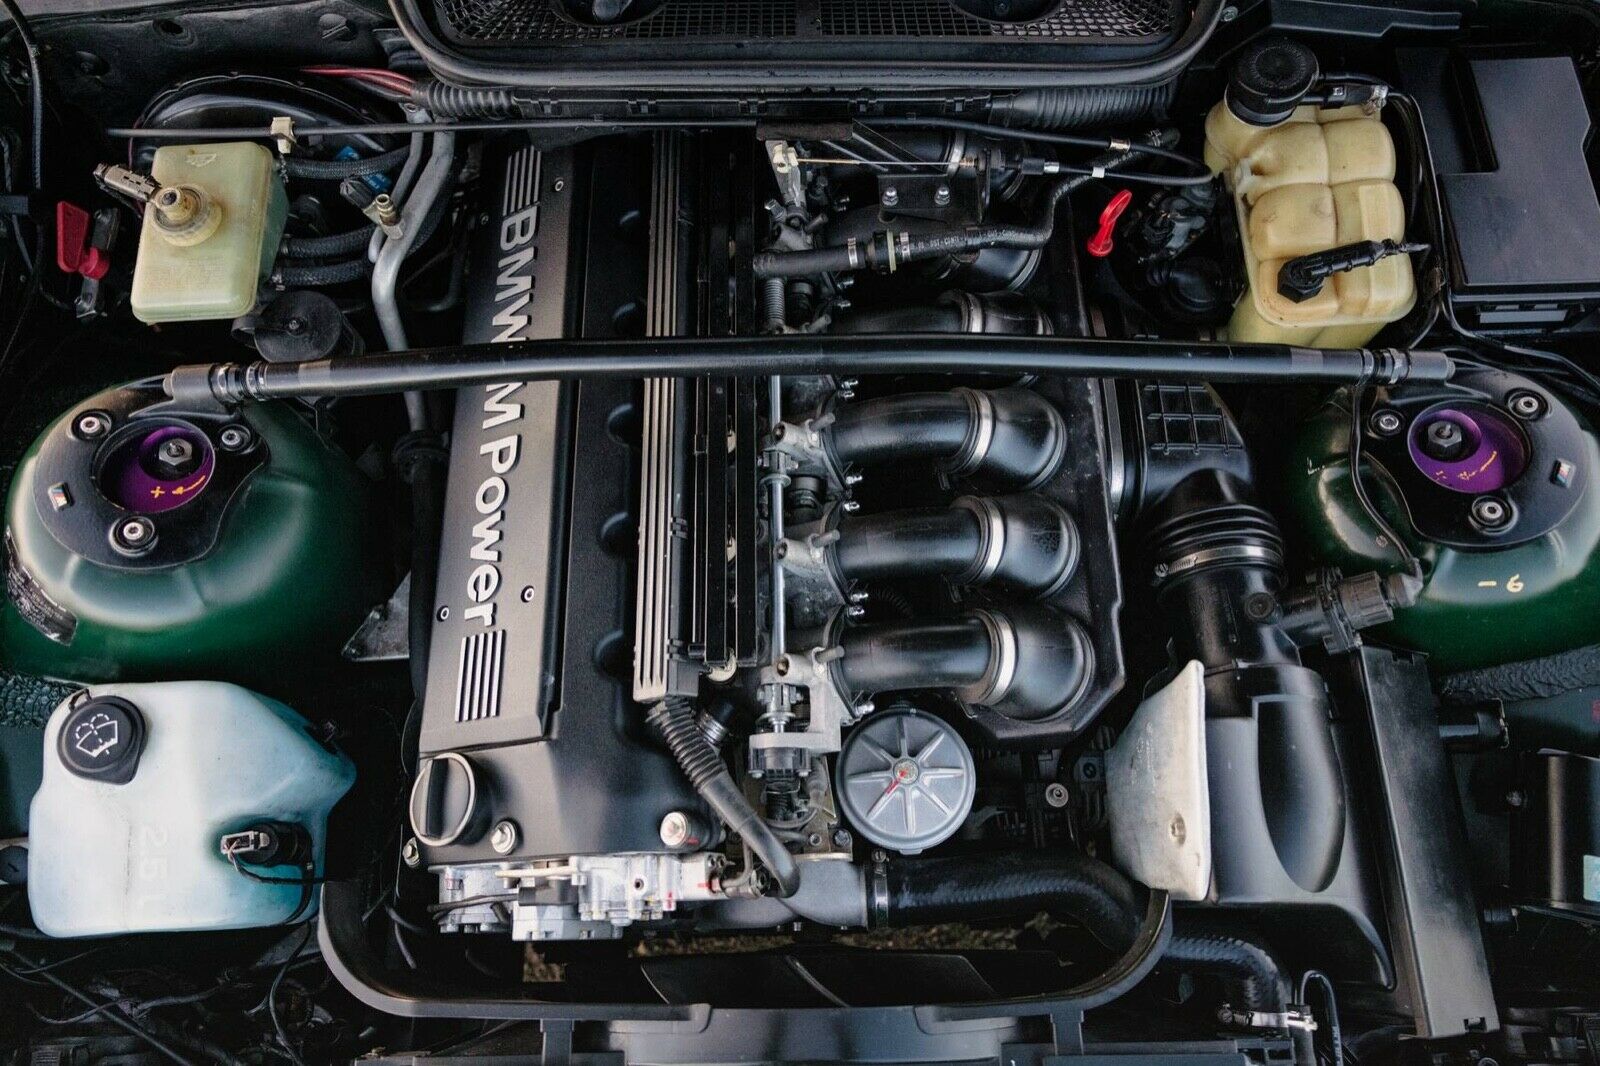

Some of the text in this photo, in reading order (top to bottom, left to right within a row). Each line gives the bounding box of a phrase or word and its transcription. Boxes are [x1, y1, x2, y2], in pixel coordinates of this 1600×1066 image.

[464, 206, 538, 627] BMW M Power
